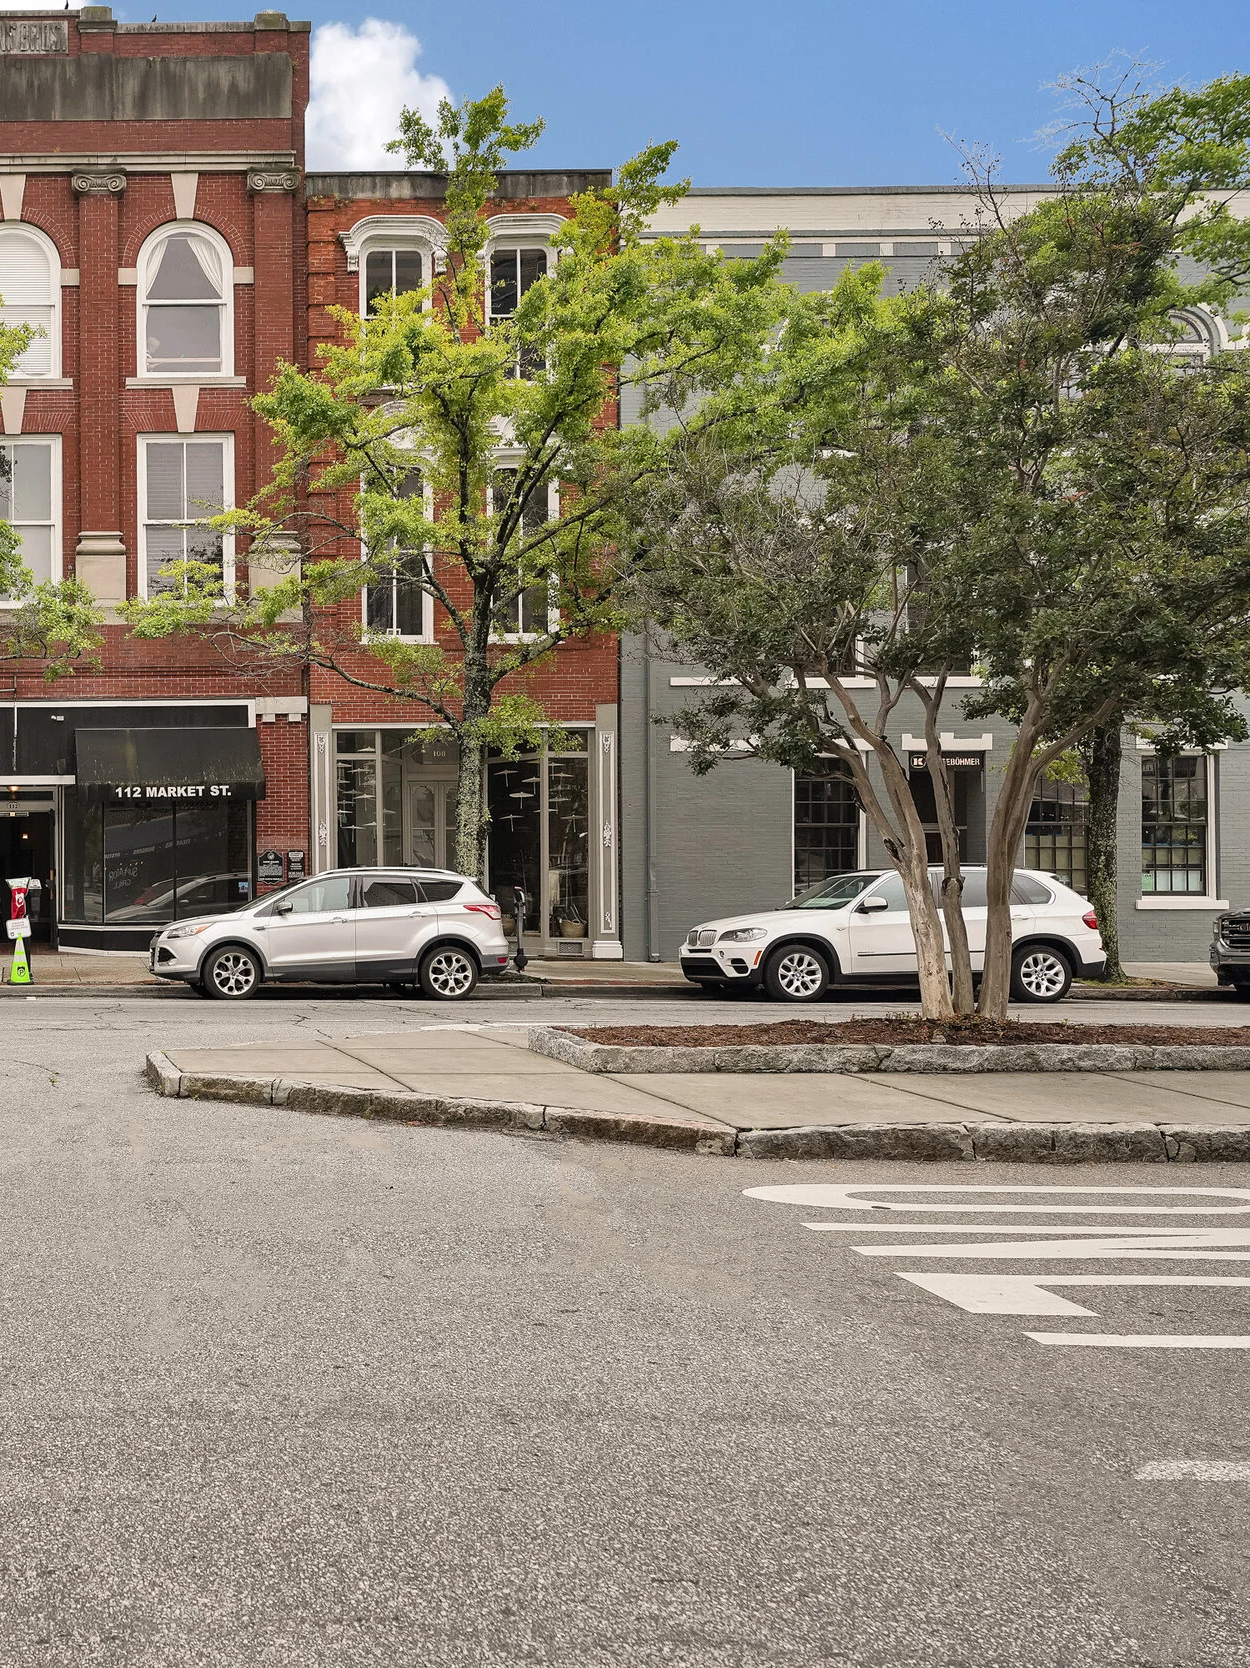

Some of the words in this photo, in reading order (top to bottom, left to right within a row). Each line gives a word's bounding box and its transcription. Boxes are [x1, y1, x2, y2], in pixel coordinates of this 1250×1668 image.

[942, 756, 980, 766] EBÖHMER
[115, 786, 142, 798] 112
[146, 785, 205, 798] MARKET
[210, 785, 232, 797] ST.
